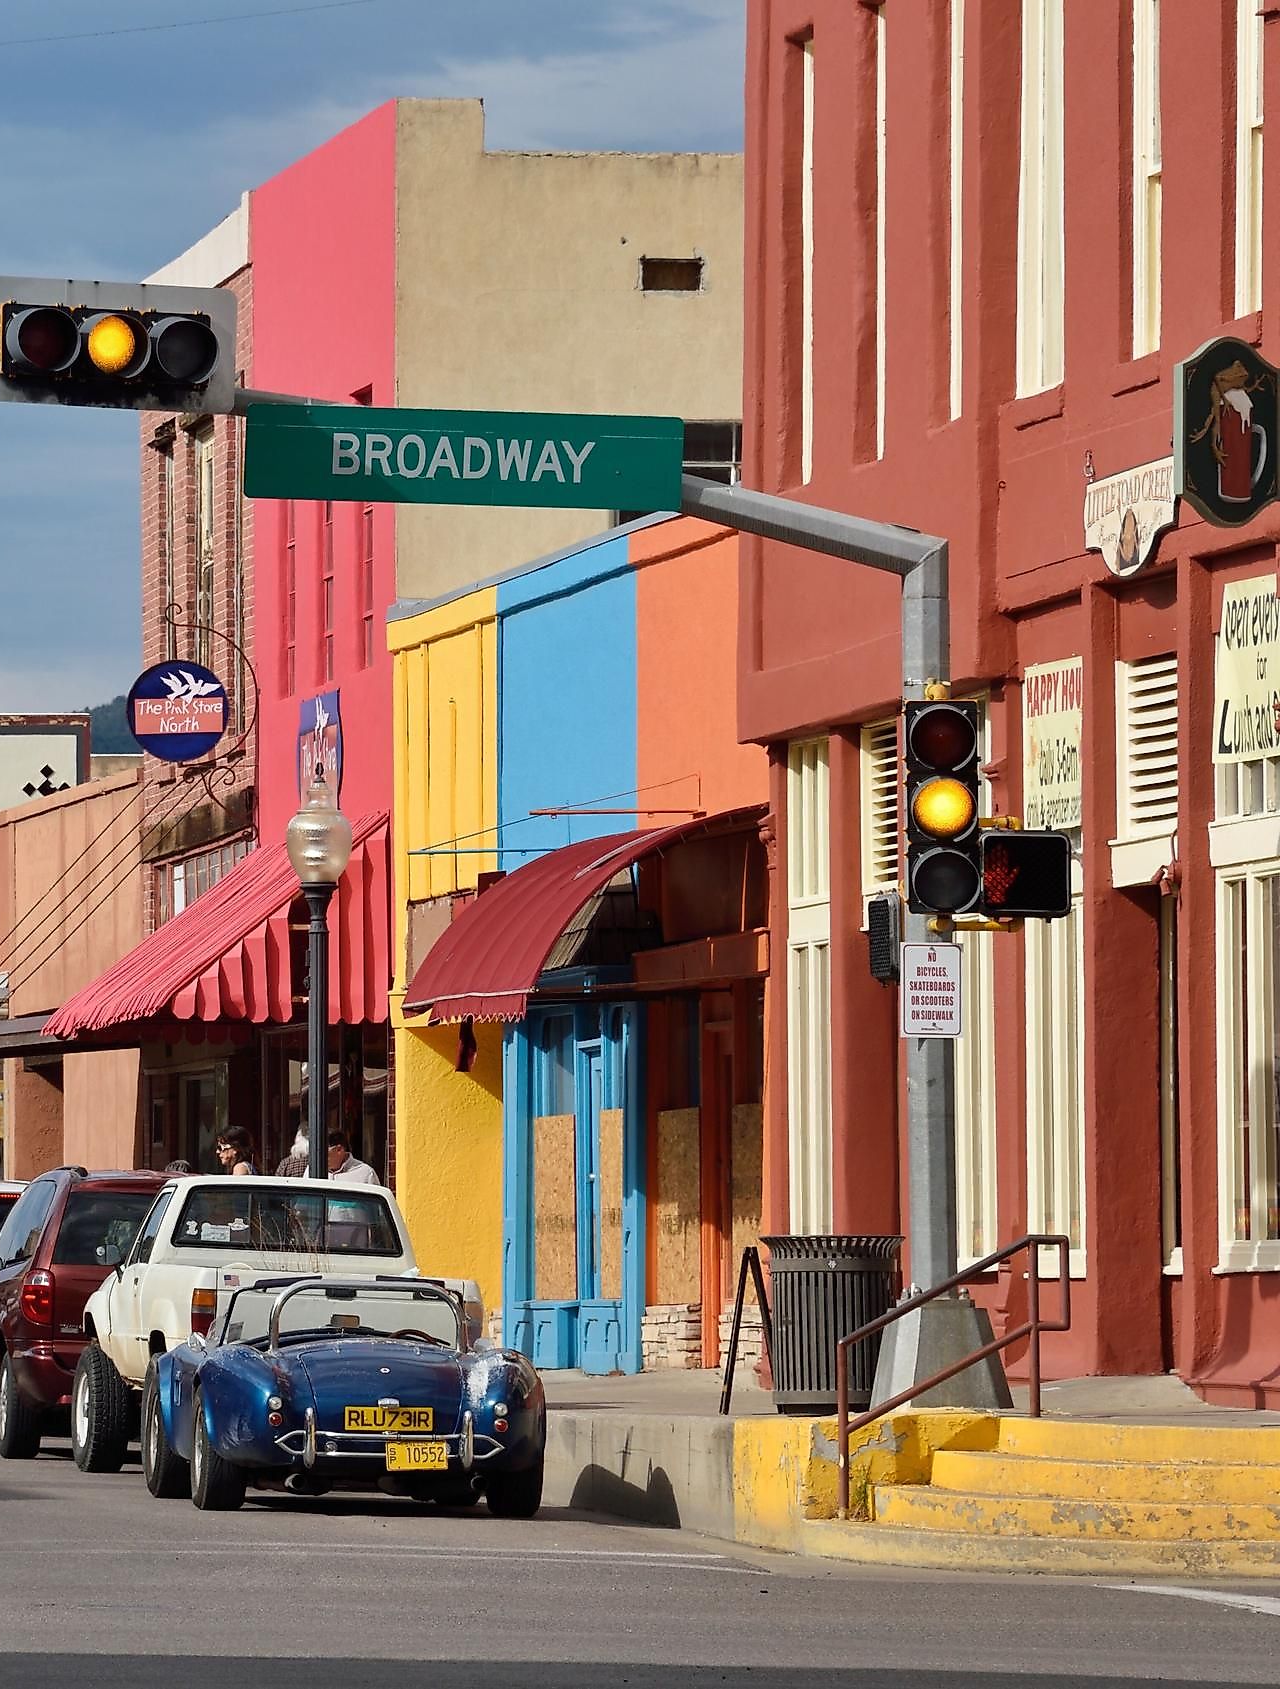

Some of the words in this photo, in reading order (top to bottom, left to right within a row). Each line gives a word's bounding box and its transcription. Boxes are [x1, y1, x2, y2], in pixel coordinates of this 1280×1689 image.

[331, 432, 596, 484] BROADWAY
[1141, 465, 1173, 504] CREEK
[1026, 671, 1060, 718] HAPPY
[137, 700, 163, 716] The
[164, 701, 190, 715] Pink
[192, 701, 223, 714] Store
[159, 716, 200, 733] North
[1218, 694, 1255, 755] Lunch
[927, 952, 937, 962] NO
[909, 981, 956, 992] SKATEBOARDS
[911, 995, 920, 1006] OR
[920, 995, 954, 1007] SCOOTERS
[911, 1010, 920, 1020] ON
[920, 1010, 954, 1021] SIDEWALK
[406, 1446, 445, 1464] 10552
